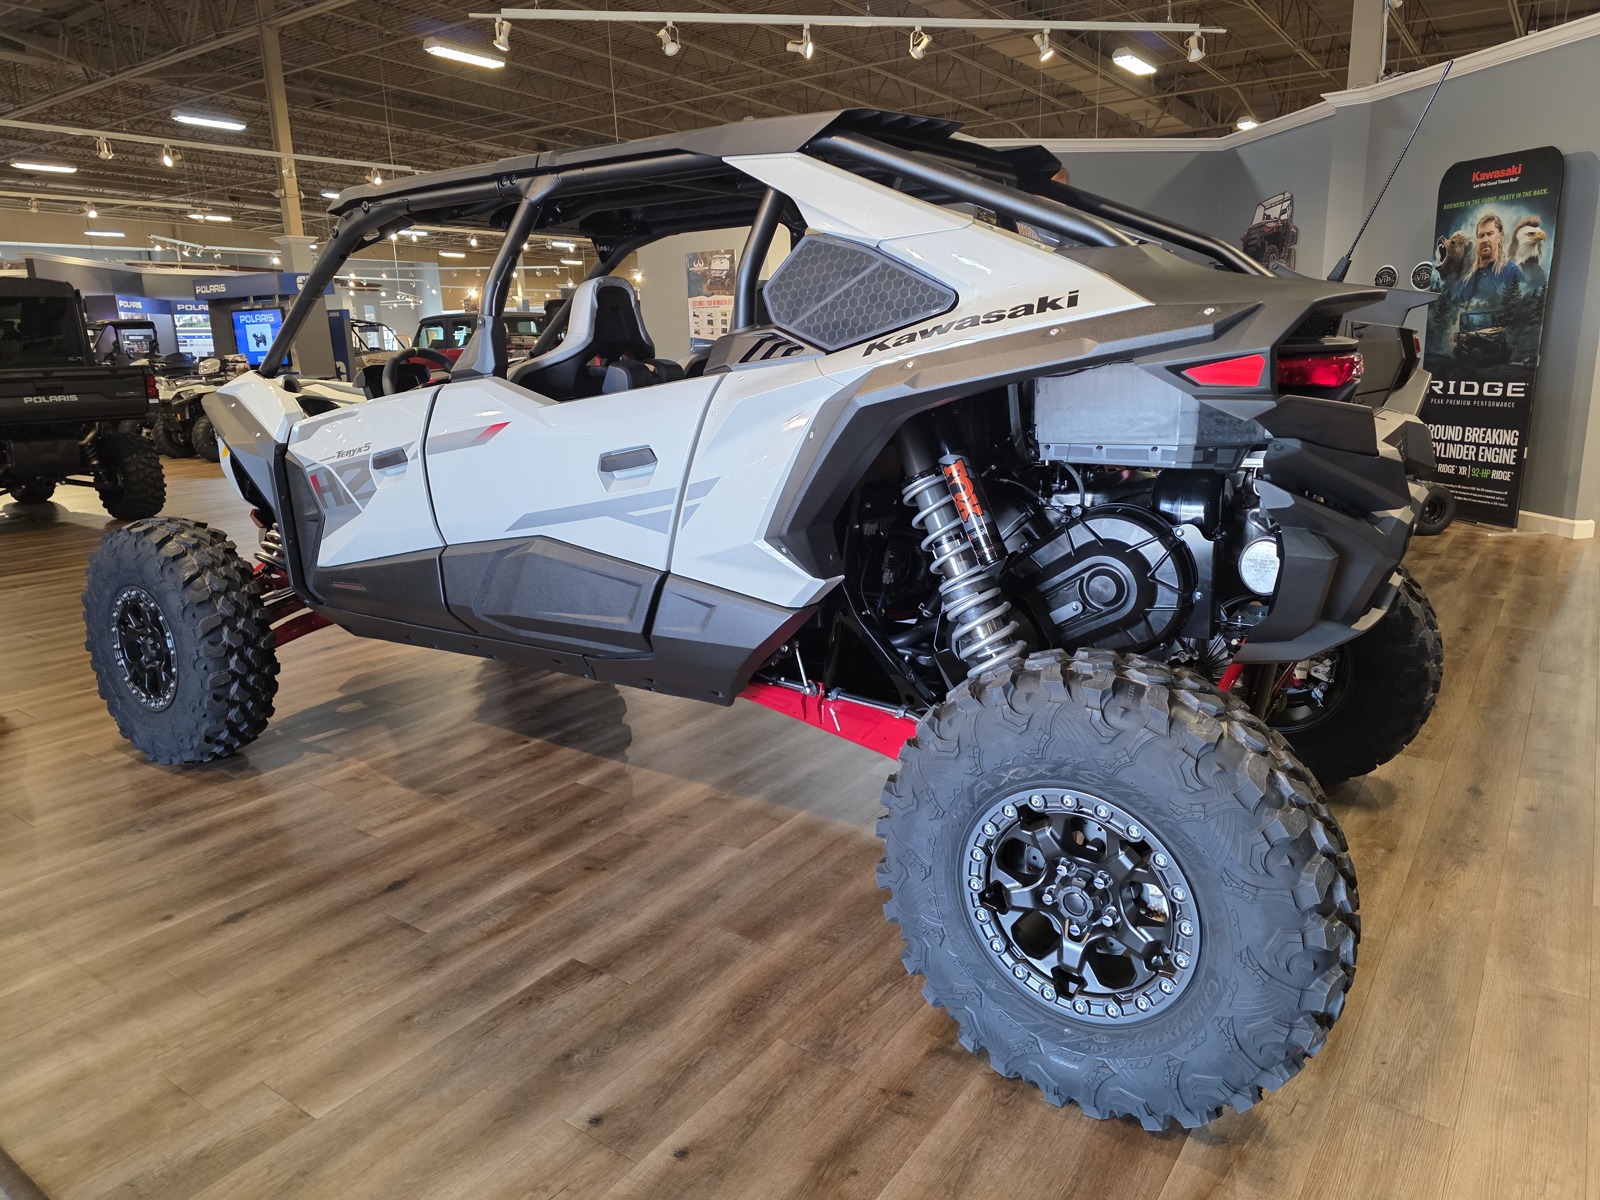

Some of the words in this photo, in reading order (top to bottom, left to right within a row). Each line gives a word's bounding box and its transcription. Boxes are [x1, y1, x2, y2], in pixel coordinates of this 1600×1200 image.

[1472, 164, 1523, 182] Kawasaki
[1443, 202, 1466, 210] BUSINESS
[1532, 188, 1549, 197] BACK.
[1379, 276, 1391, 284] VIP
[1416, 273, 1430, 281] VIP
[195, 283, 227, 294] POLARIS
[118, 300, 143, 309] POLARIS
[239, 313, 275, 324] POLARIS
[862, 289, 1080, 357] Kawasaki
[1427, 380, 1526, 397] RIDGE
[23, 395, 79, 404] POLARIS
[1446, 398, 1471, 406] PREMIUM
[1473, 400, 1515, 408] PERFORMANCE
[1425, 424, 1463, 441] ROUND
[1464, 426, 1520, 446] BREAKING
[1478, 445, 1518, 465] ENGINE
[1437, 463, 1456, 474] RIDGE
[1458, 466, 1468, 476] XR
[1471, 467, 1492, 478] 92-HP
[1491, 469, 1512, 481] RIDGE
[943, 458, 985, 523] FOX
